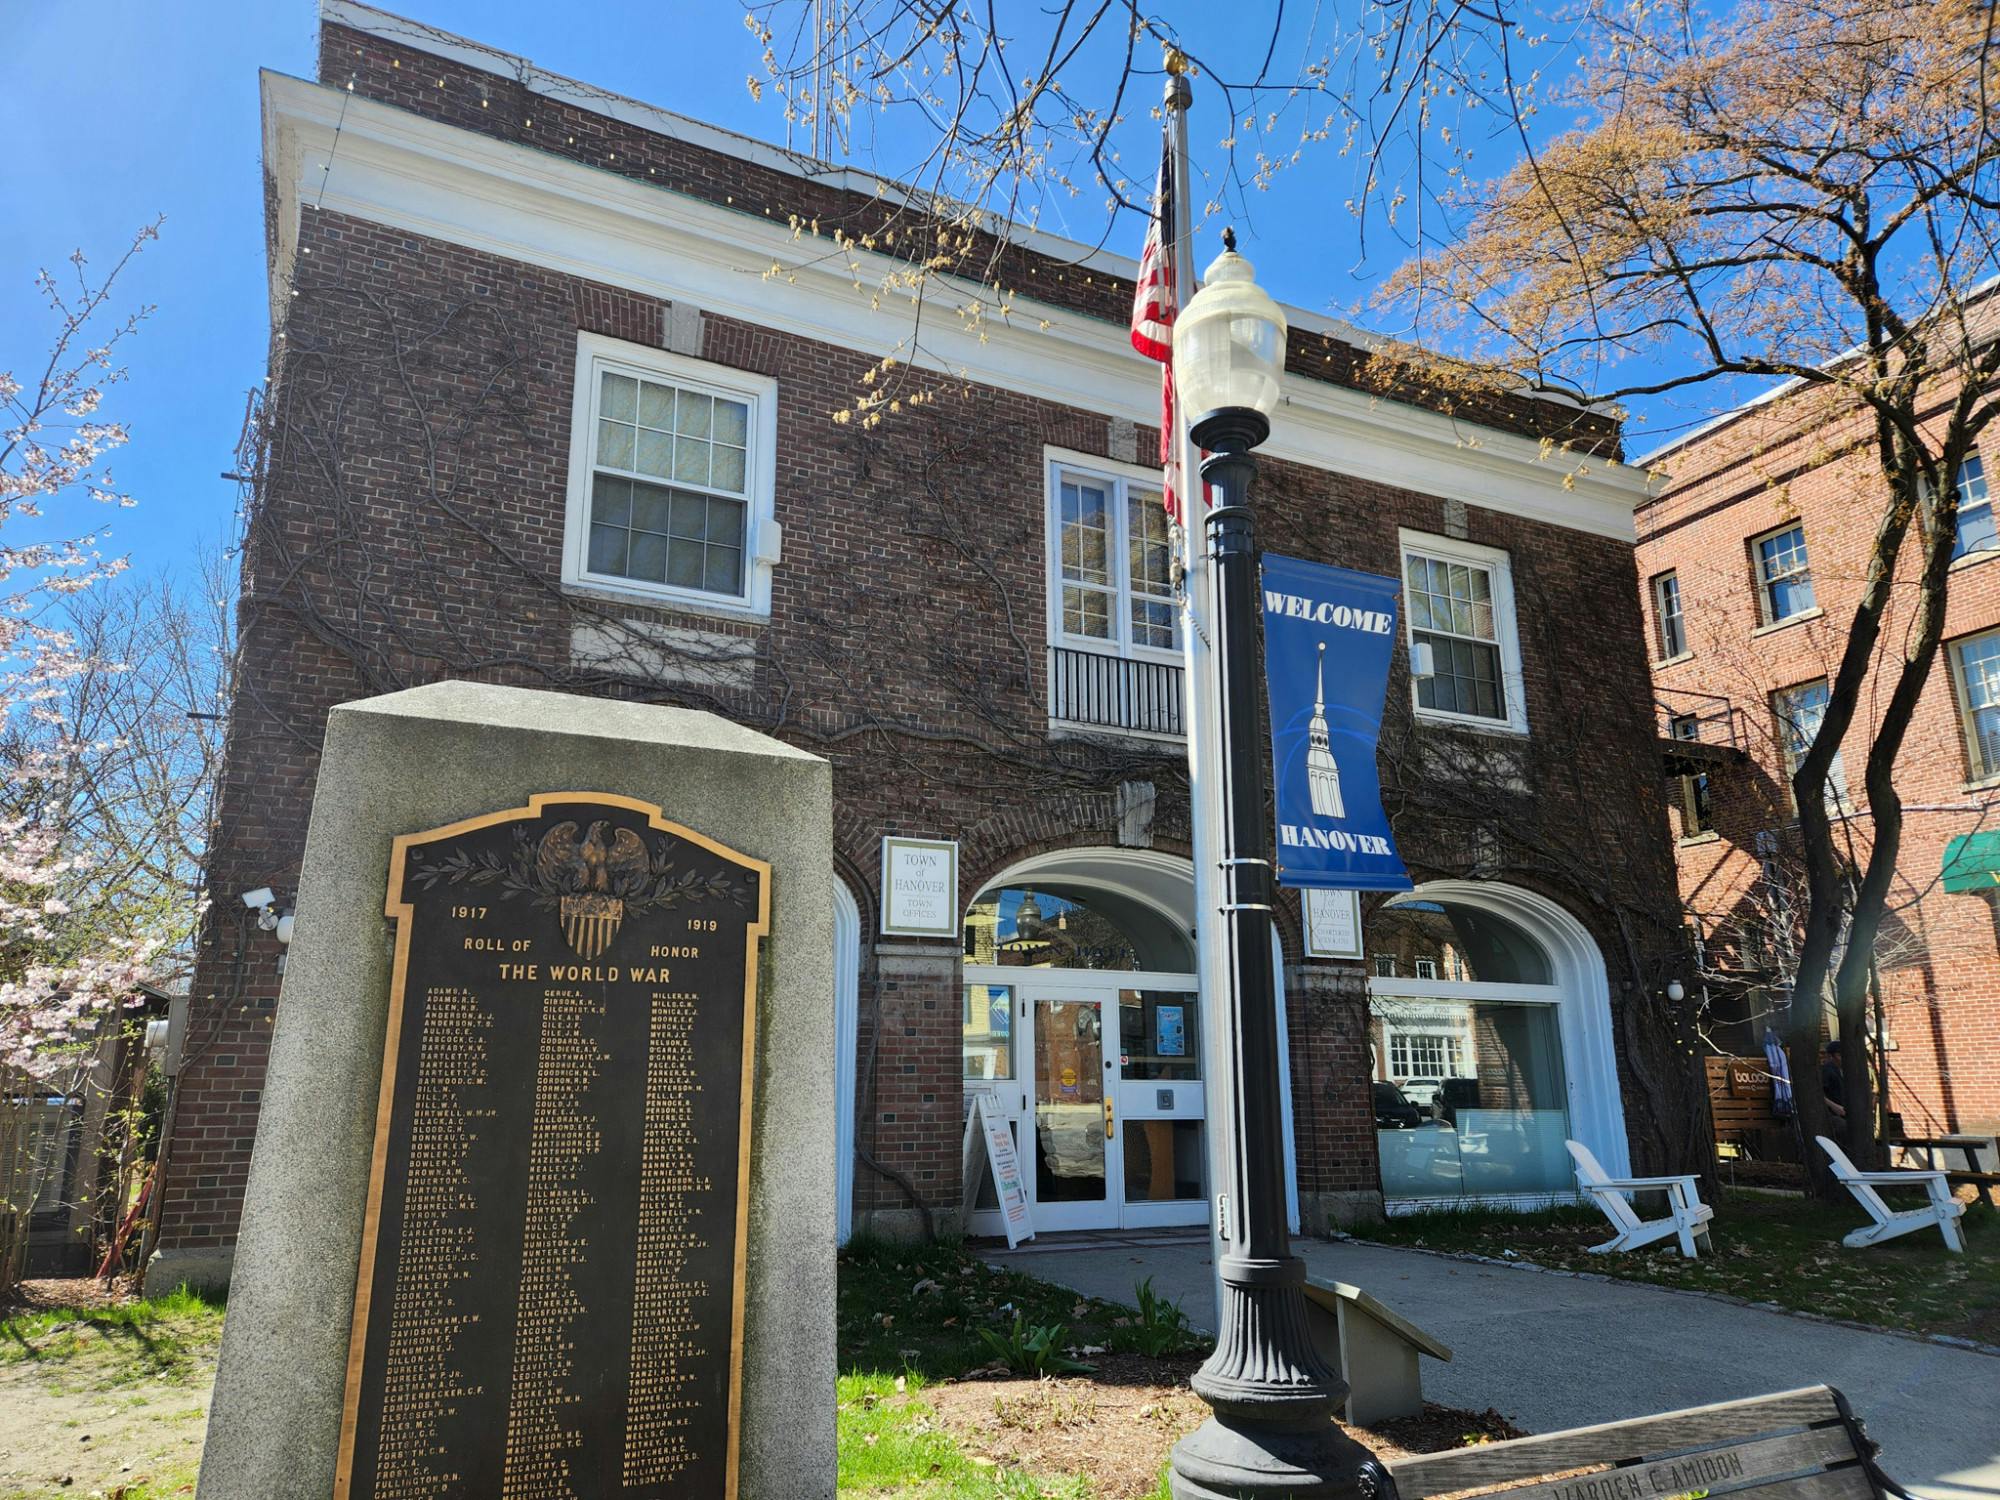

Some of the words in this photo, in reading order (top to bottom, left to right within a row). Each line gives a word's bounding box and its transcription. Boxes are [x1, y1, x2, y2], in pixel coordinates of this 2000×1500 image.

[1264, 590, 1392, 635] WELCOME
[1280, 824, 1391, 856] HANOVER
[904, 854, 937, 866] TOWN
[895, 879, 945, 893] HANOVER
[908, 899, 932, 908] TOWN
[453, 907, 486, 918] 1917
[902, 909, 937, 919] OFFICES
[1313, 908, 1351, 920] HANOVER
[688, 920, 716, 931] 1919
[465, 938, 504, 950] ROLL
[513, 941, 530, 951] OF
[651, 946, 697, 958] HONOR
[500, 965, 537, 979] THE
[551, 966, 618, 981] WORLD
[631, 968, 669, 982] WAR
[1671, 1451, 1744, 1489] AMIDON
